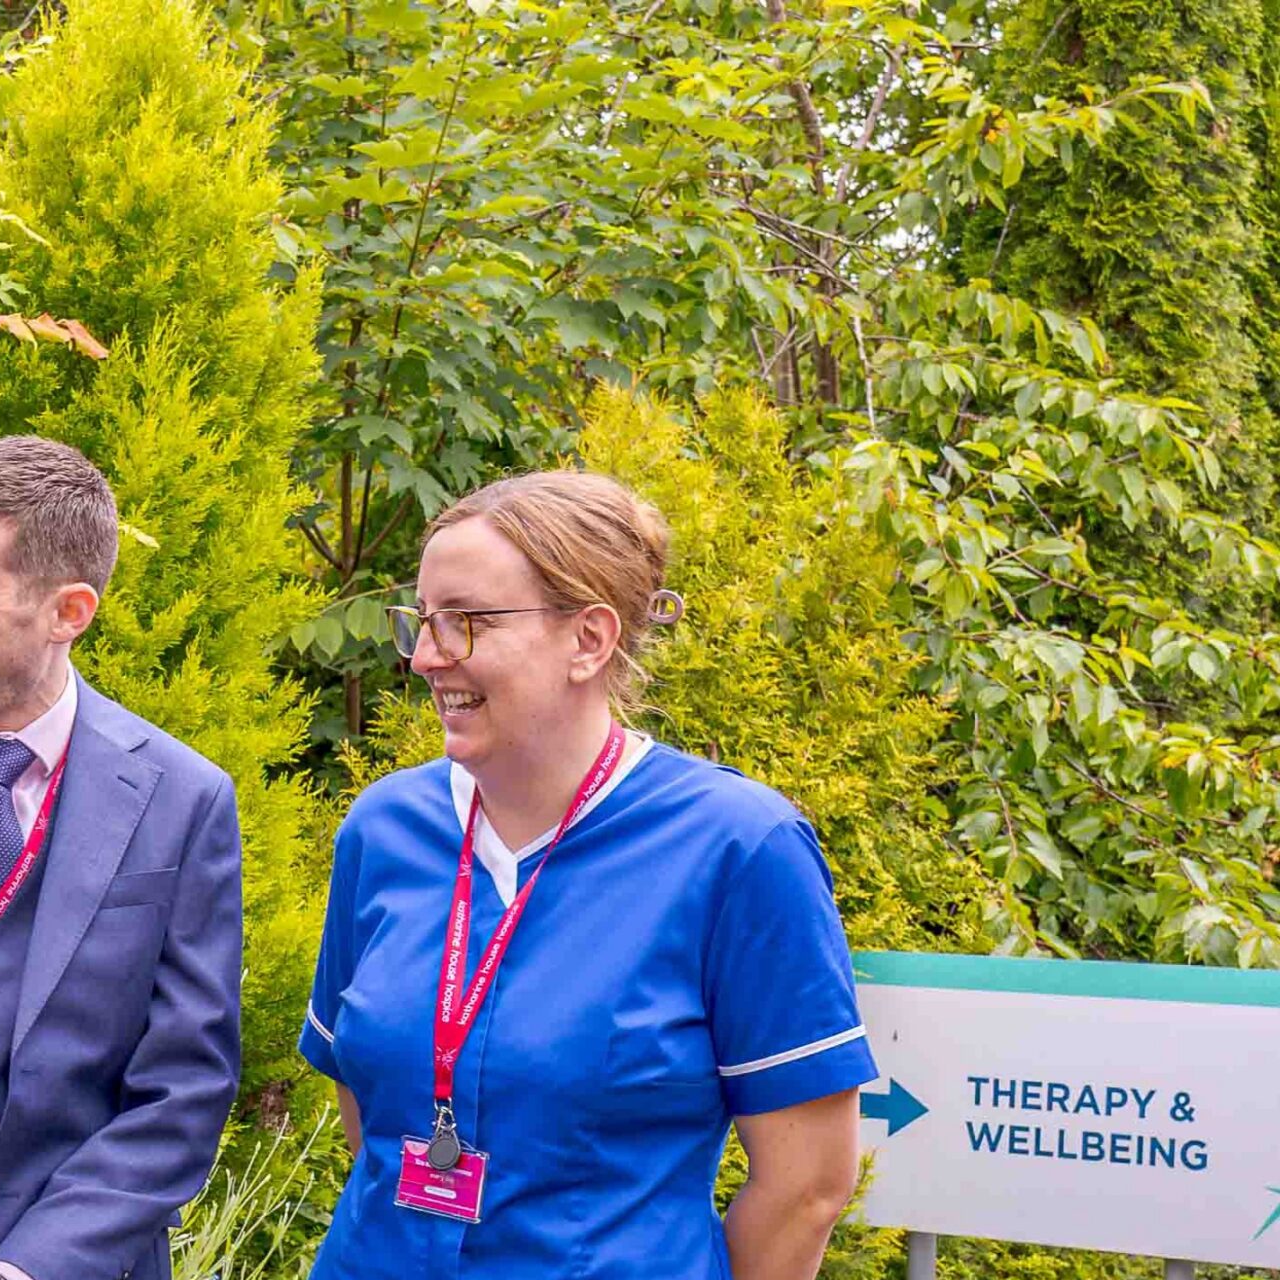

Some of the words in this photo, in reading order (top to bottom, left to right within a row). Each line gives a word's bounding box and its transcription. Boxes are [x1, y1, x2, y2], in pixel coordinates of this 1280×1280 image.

[583, 770, 605, 798] house
[600, 737, 621, 770] hospice
[7, 852, 35, 896] katharine
[452, 899, 468, 948] katharine
[446, 950, 462, 981] house
[456, 976, 486, 1026] katharine
[479, 943, 501, 974] house
[496, 904, 520, 941] hospice
[441, 984, 457, 1023] hospice
[967, 1076, 1156, 1119] THERAPY
[1169, 1091, 1195, 1122] &
[965, 1121, 1209, 1171] WELLBEING
